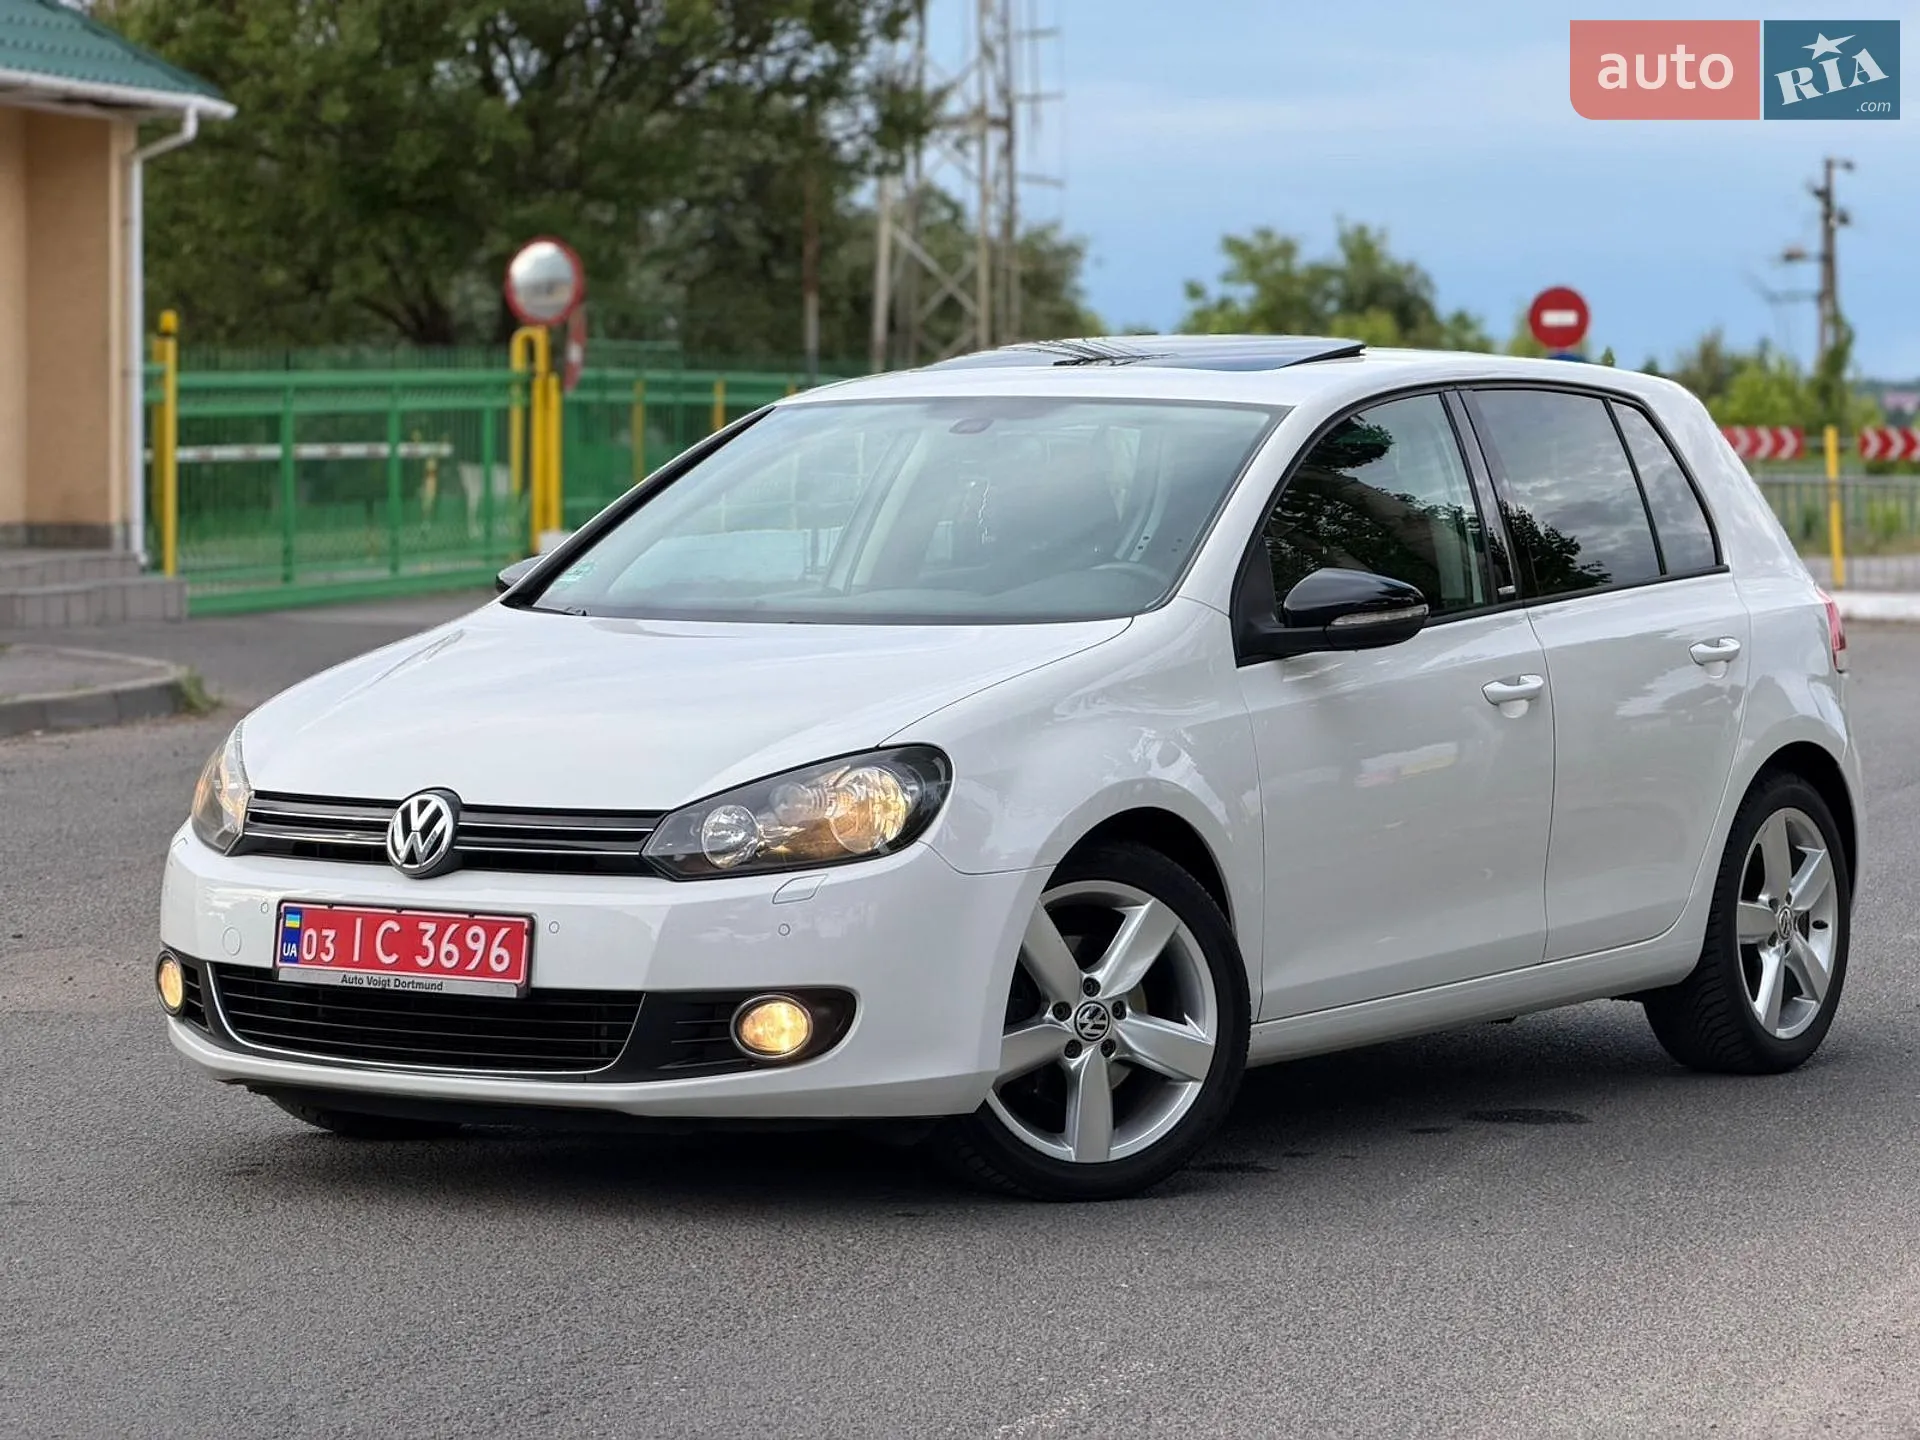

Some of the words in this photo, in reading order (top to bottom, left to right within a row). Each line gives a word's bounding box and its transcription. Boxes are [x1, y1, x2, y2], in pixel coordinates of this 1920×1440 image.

[390, 796, 450, 868] VW
[282, 942, 298, 957] UA
[302, 927, 337, 962] 03
[414, 921, 512, 973] 3696
[340, 974, 364, 986] Auto
[366, 975, 391, 989] Voigt
[393, 978, 443, 991] Dortmund
